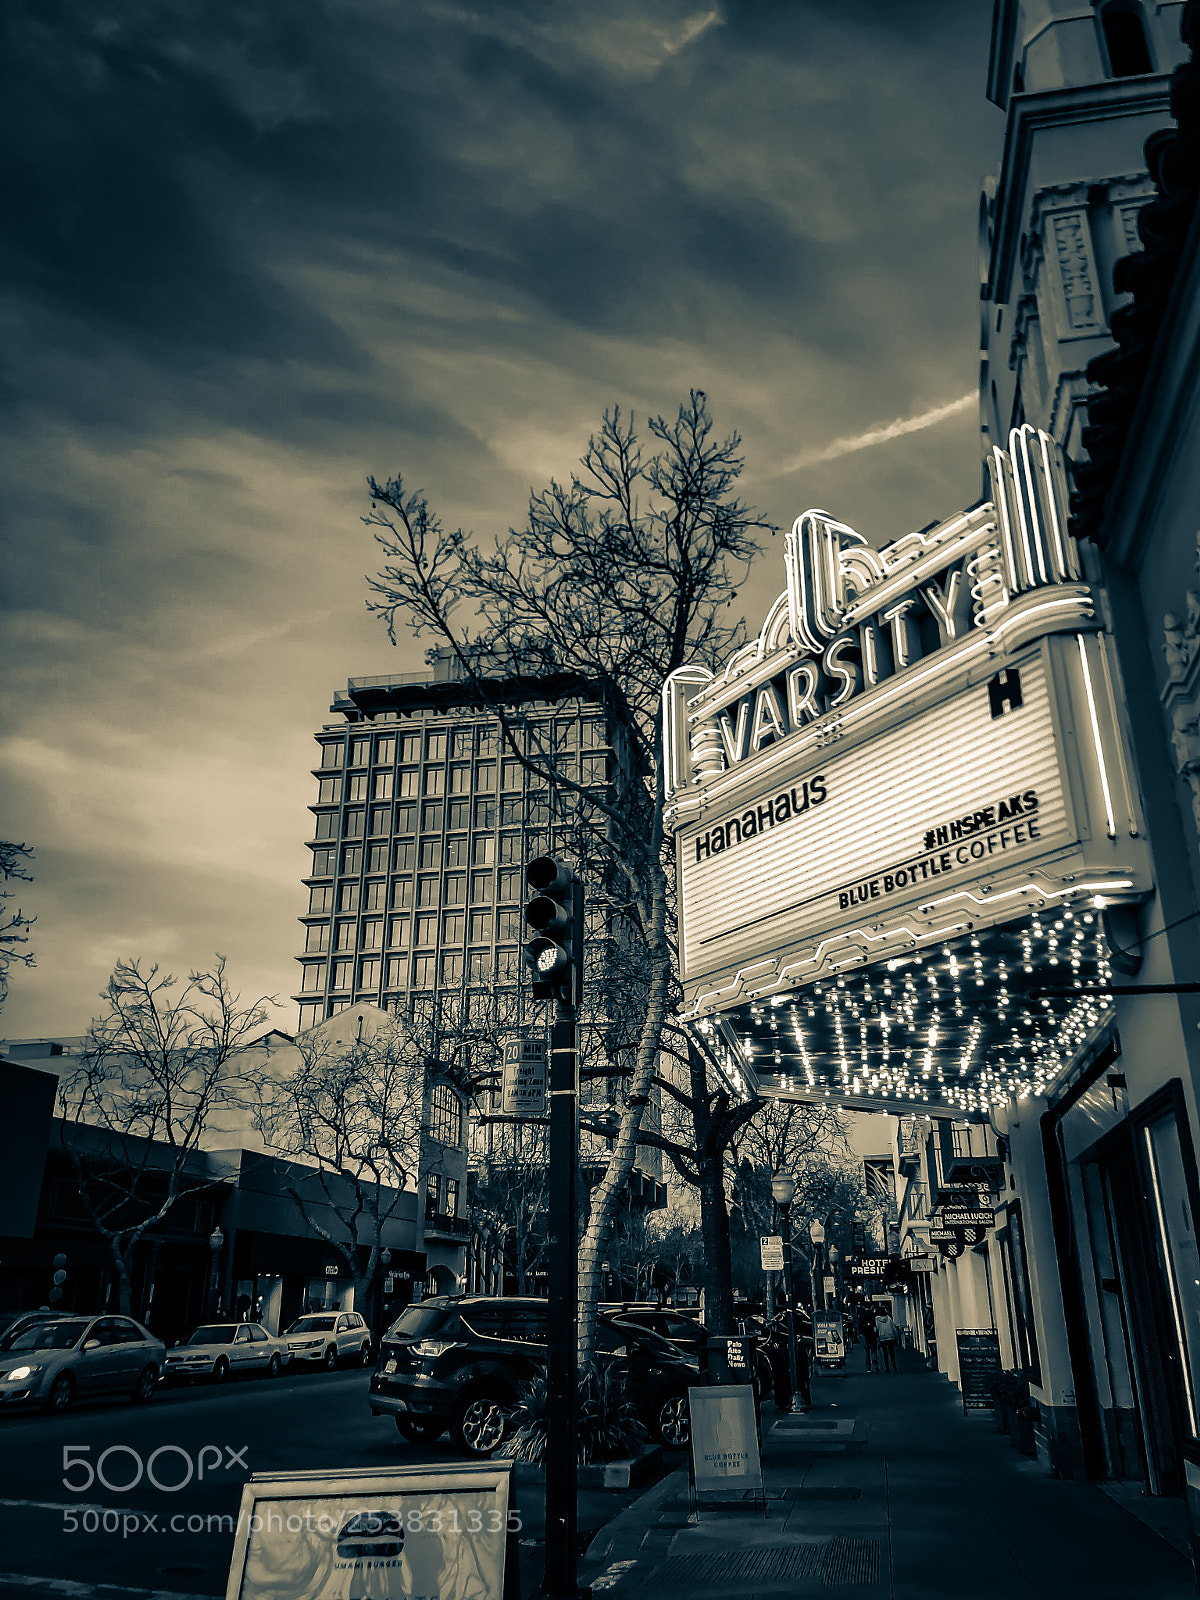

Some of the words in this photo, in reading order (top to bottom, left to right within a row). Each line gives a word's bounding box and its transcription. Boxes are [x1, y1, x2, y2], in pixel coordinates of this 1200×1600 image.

[717, 557, 972, 766] VARSITY
[988, 669, 1023, 720] H
[839, 880, 880, 909] BLUE
[884, 852, 952, 893] BOTTLE
[956, 818, 1041, 864] COFFEE
[507, 1046, 518, 1060] 20
